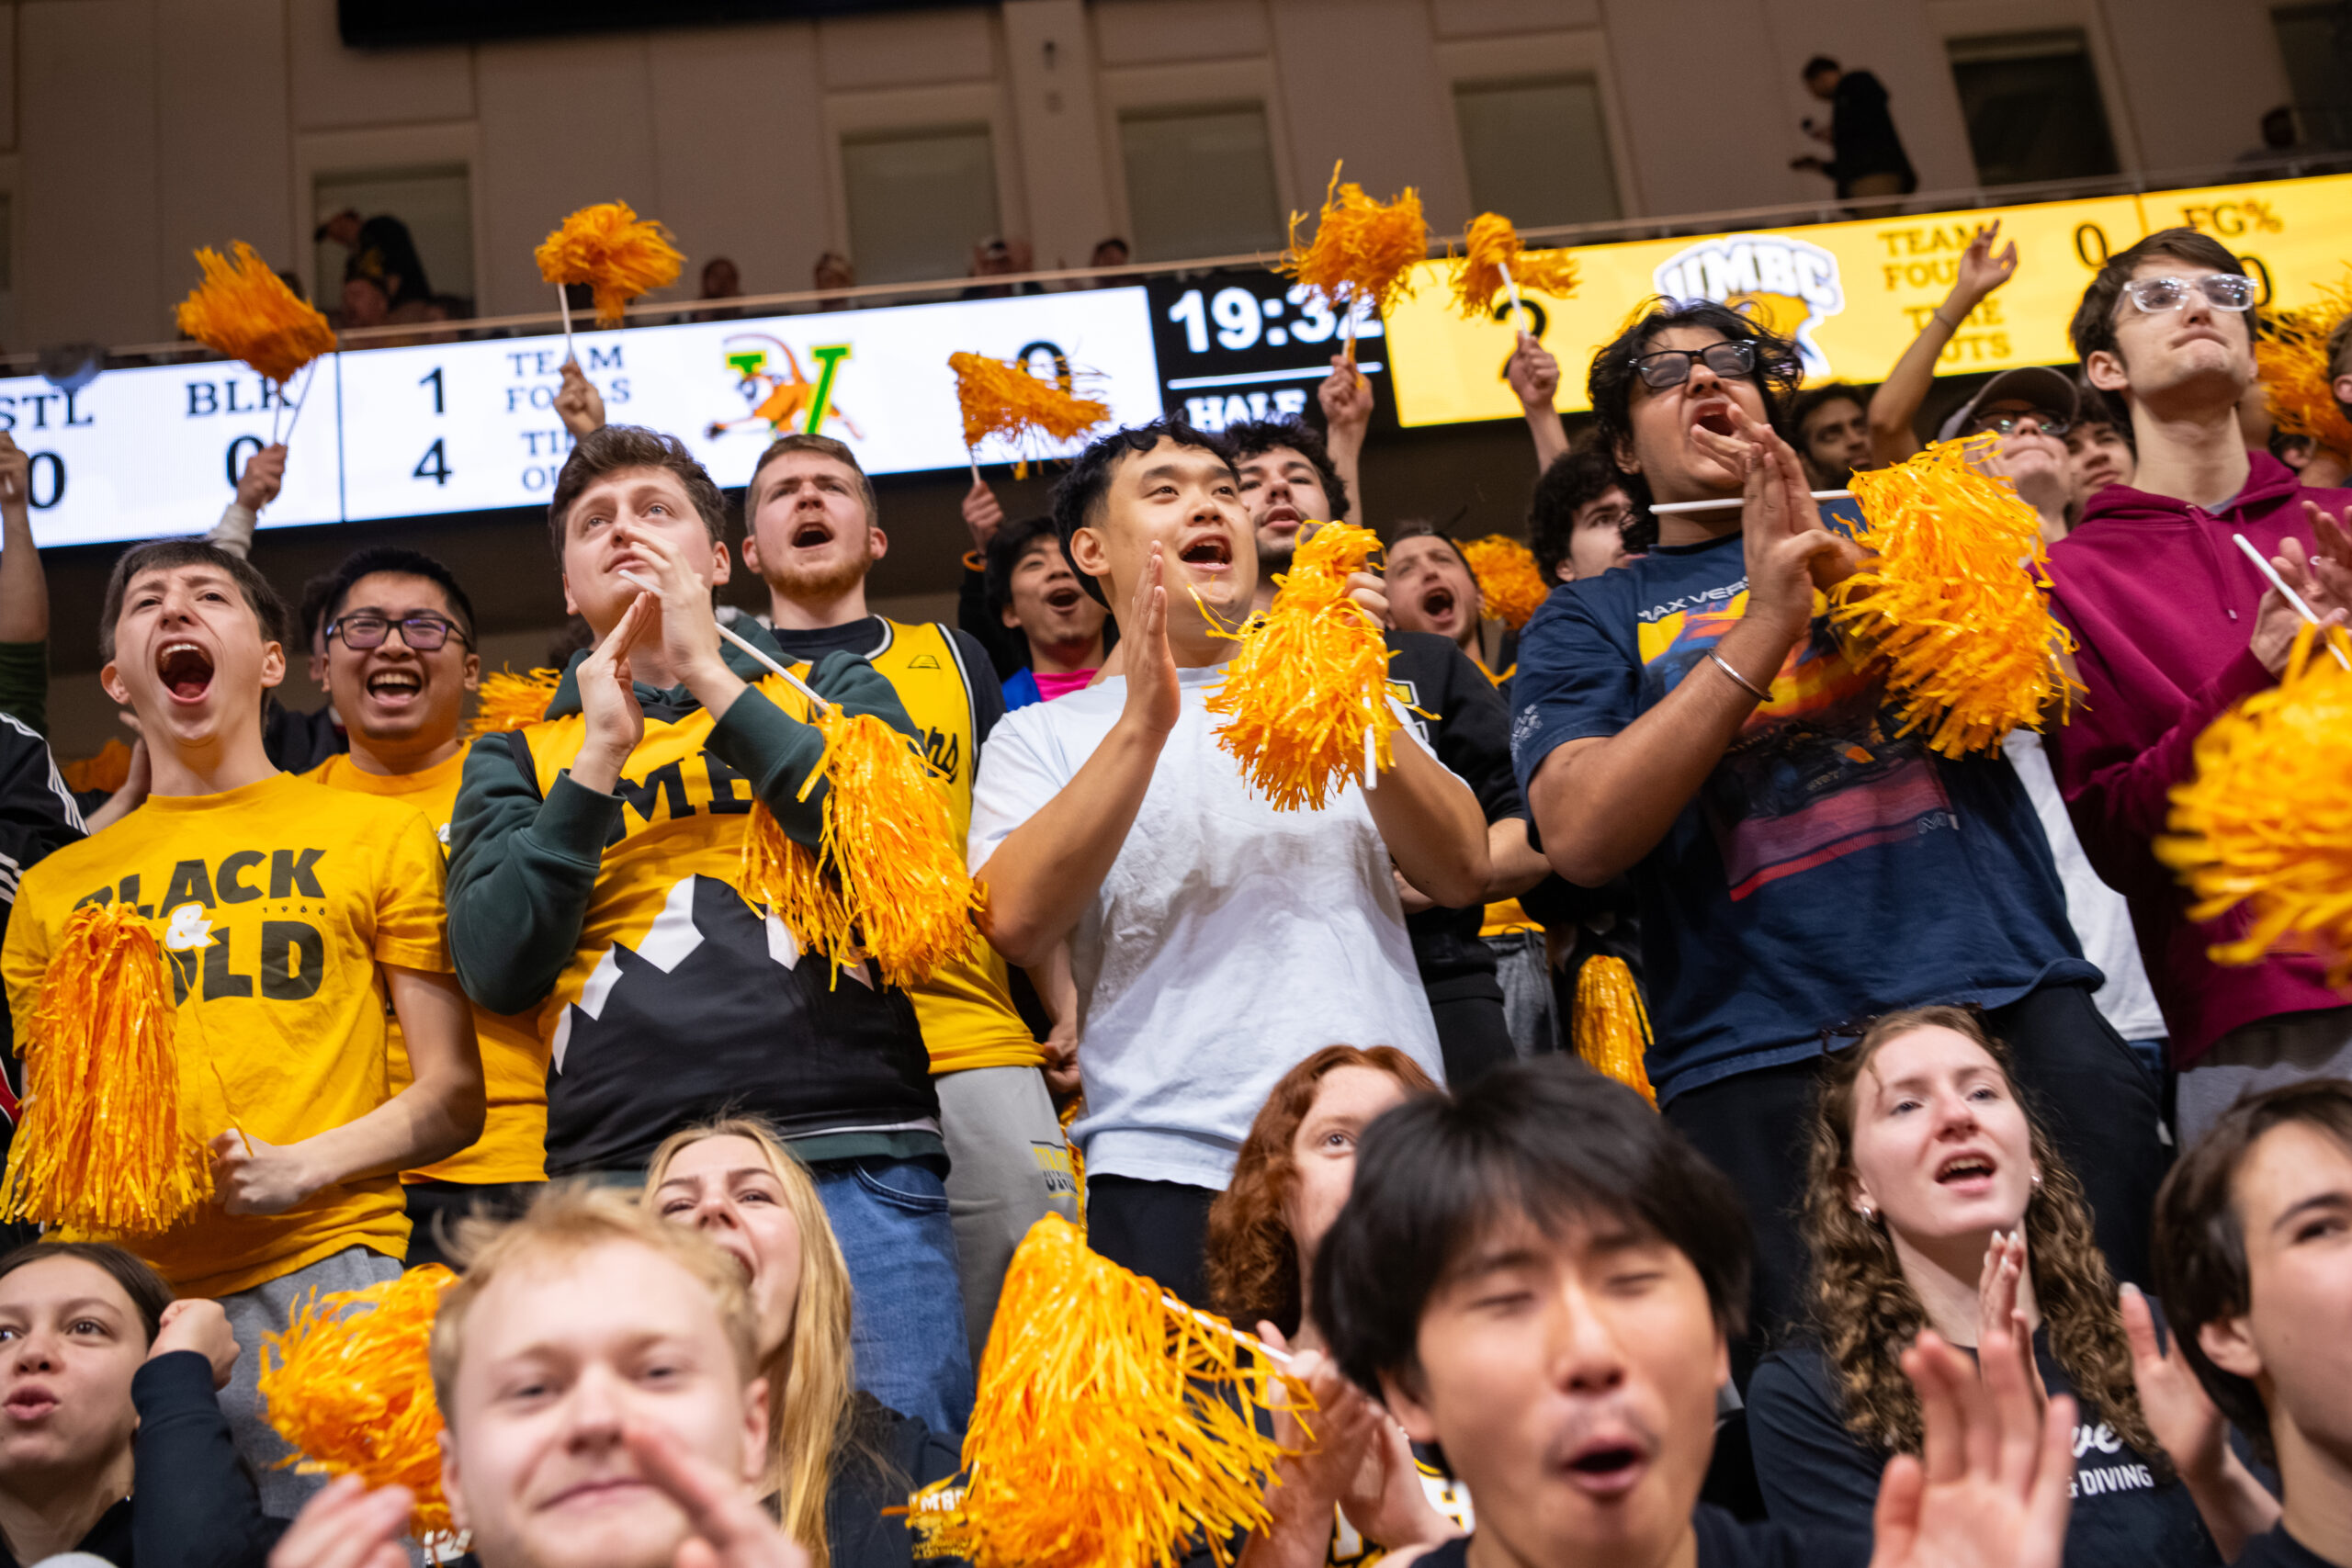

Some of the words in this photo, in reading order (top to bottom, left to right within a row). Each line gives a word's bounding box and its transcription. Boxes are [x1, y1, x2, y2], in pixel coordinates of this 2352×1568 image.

[2184, 201, 2284, 236] FG%
[2077, 224, 2109, 268] 0
[1657, 237, 1840, 308] UMBC
[1883, 260, 1960, 290] FOU
[1168, 287, 1385, 353] 19:32
[507, 345, 624, 377] TEM
[1939, 333, 2011, 362] UTS
[420, 367, 447, 414] 1
[507, 378, 631, 412] FOS
[28, 452, 65, 510] 0
[413, 437, 453, 487] 4
[263, 906, 326, 916] 1966
[157, 920, 324, 1009] LD
[2078, 1462, 2154, 1496] DIVING
